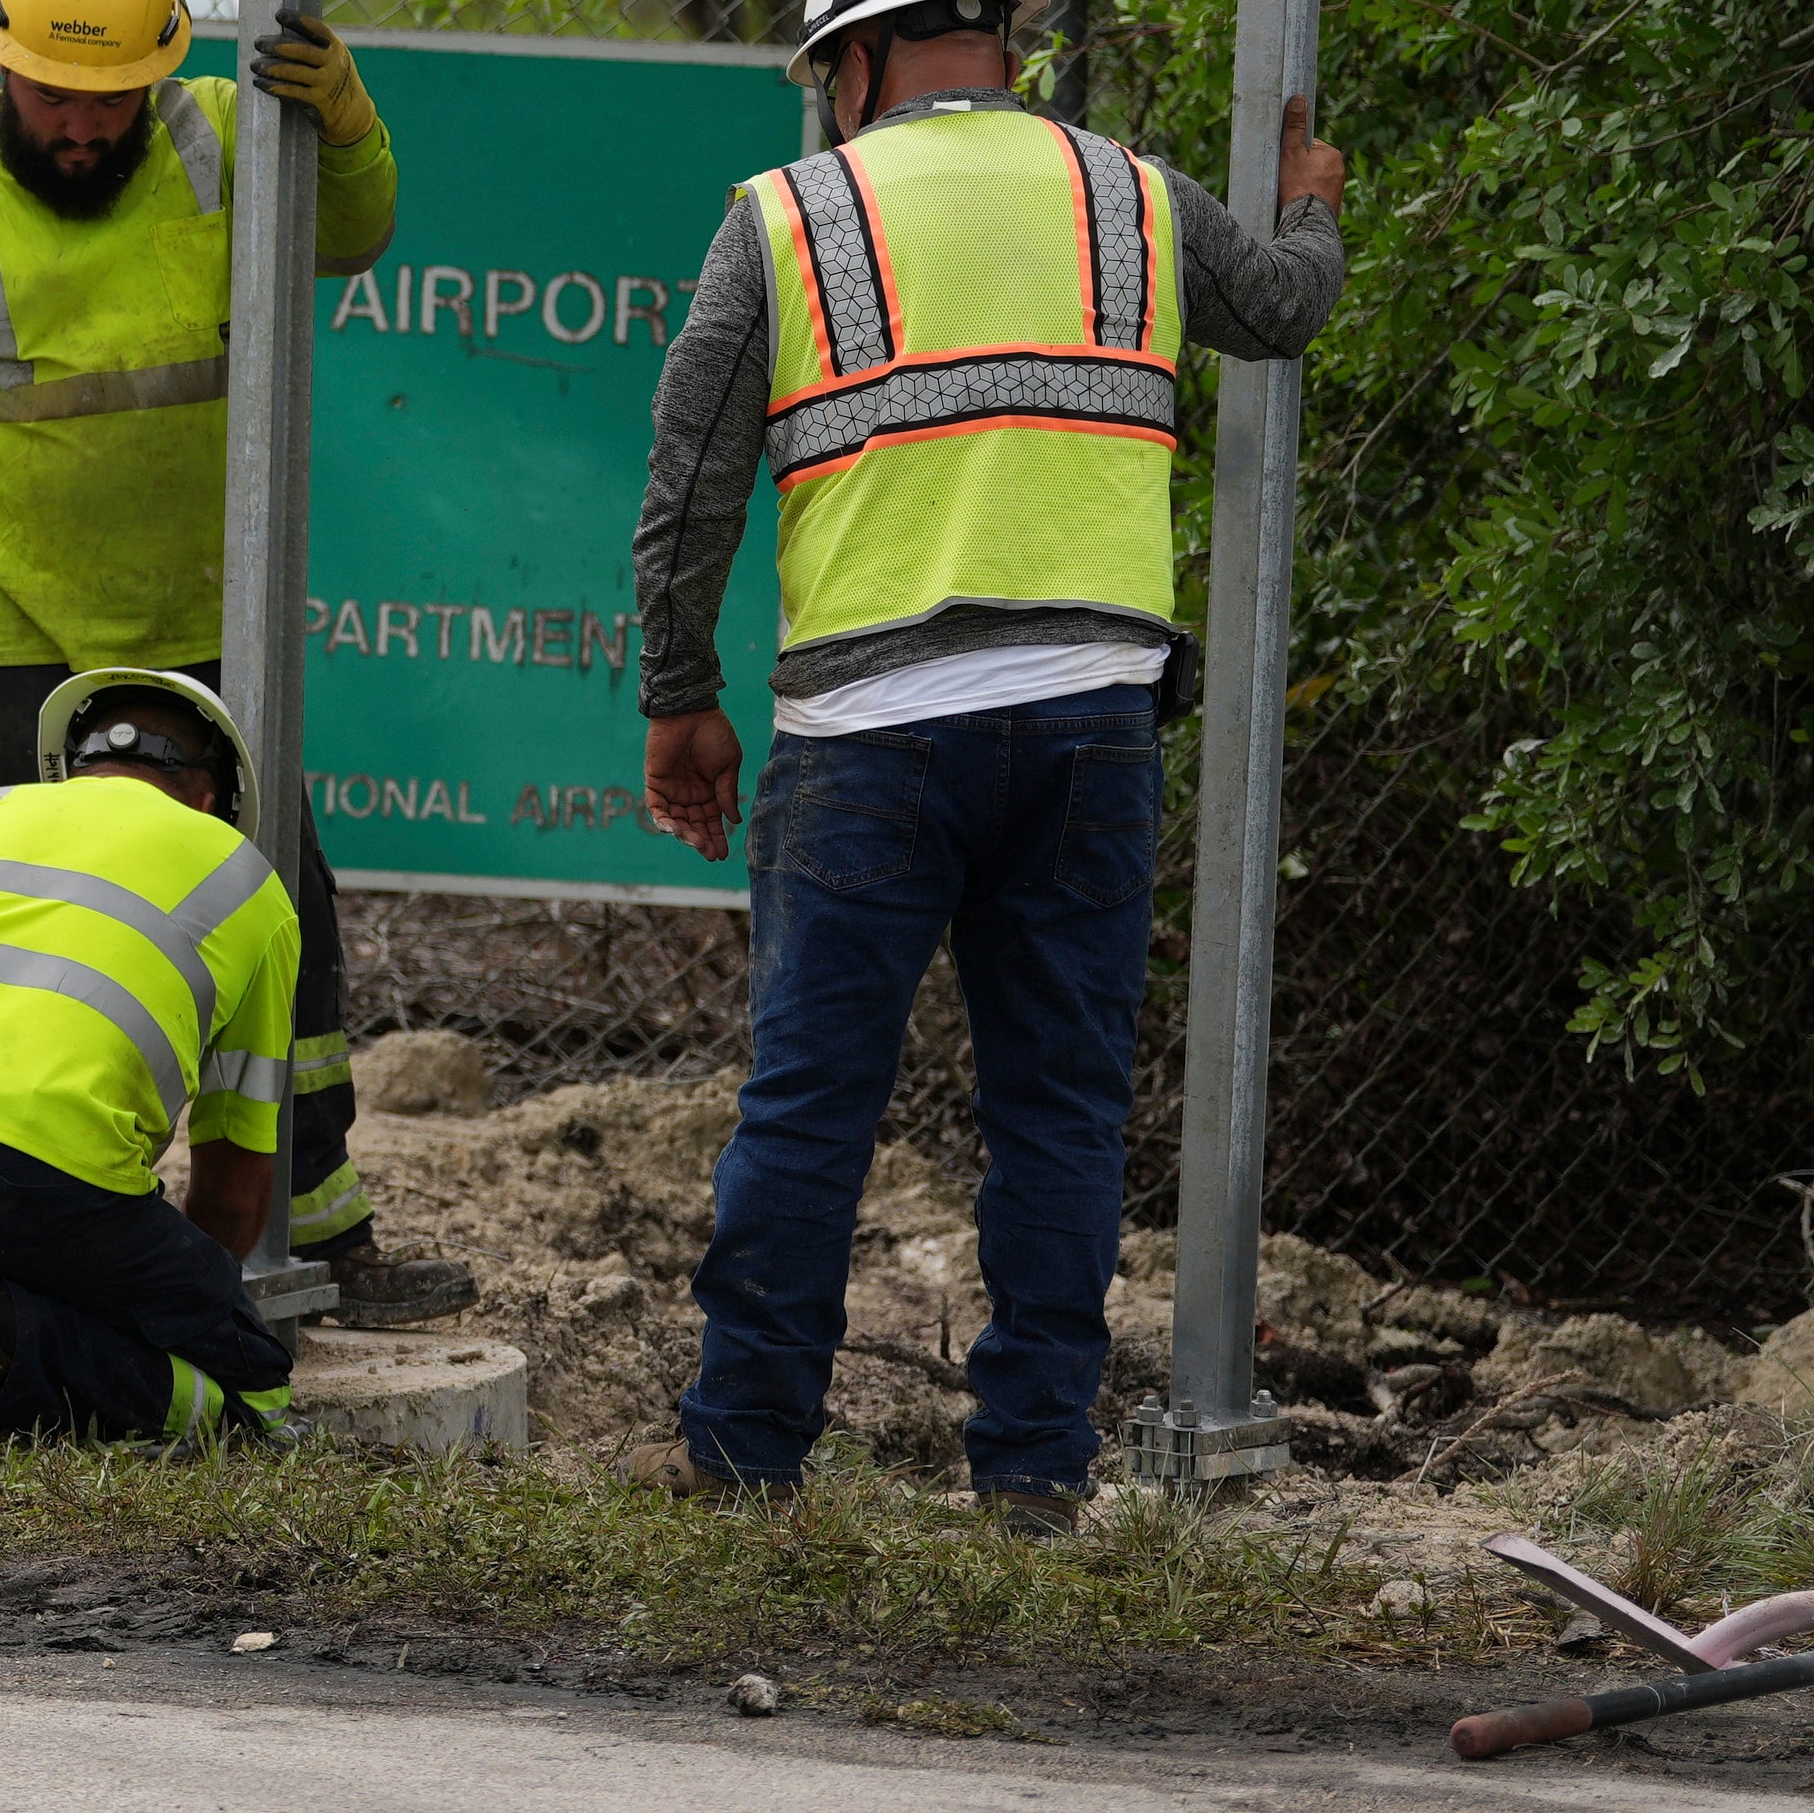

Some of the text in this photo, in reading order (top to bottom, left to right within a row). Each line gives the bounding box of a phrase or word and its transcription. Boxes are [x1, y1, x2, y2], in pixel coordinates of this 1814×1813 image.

[48, 32, 122, 48] A Ferrovial company
[50, 19, 108, 37] webber
[330, 265, 699, 346] AIRPOR
[306, 597, 643, 670] PARTMEN
